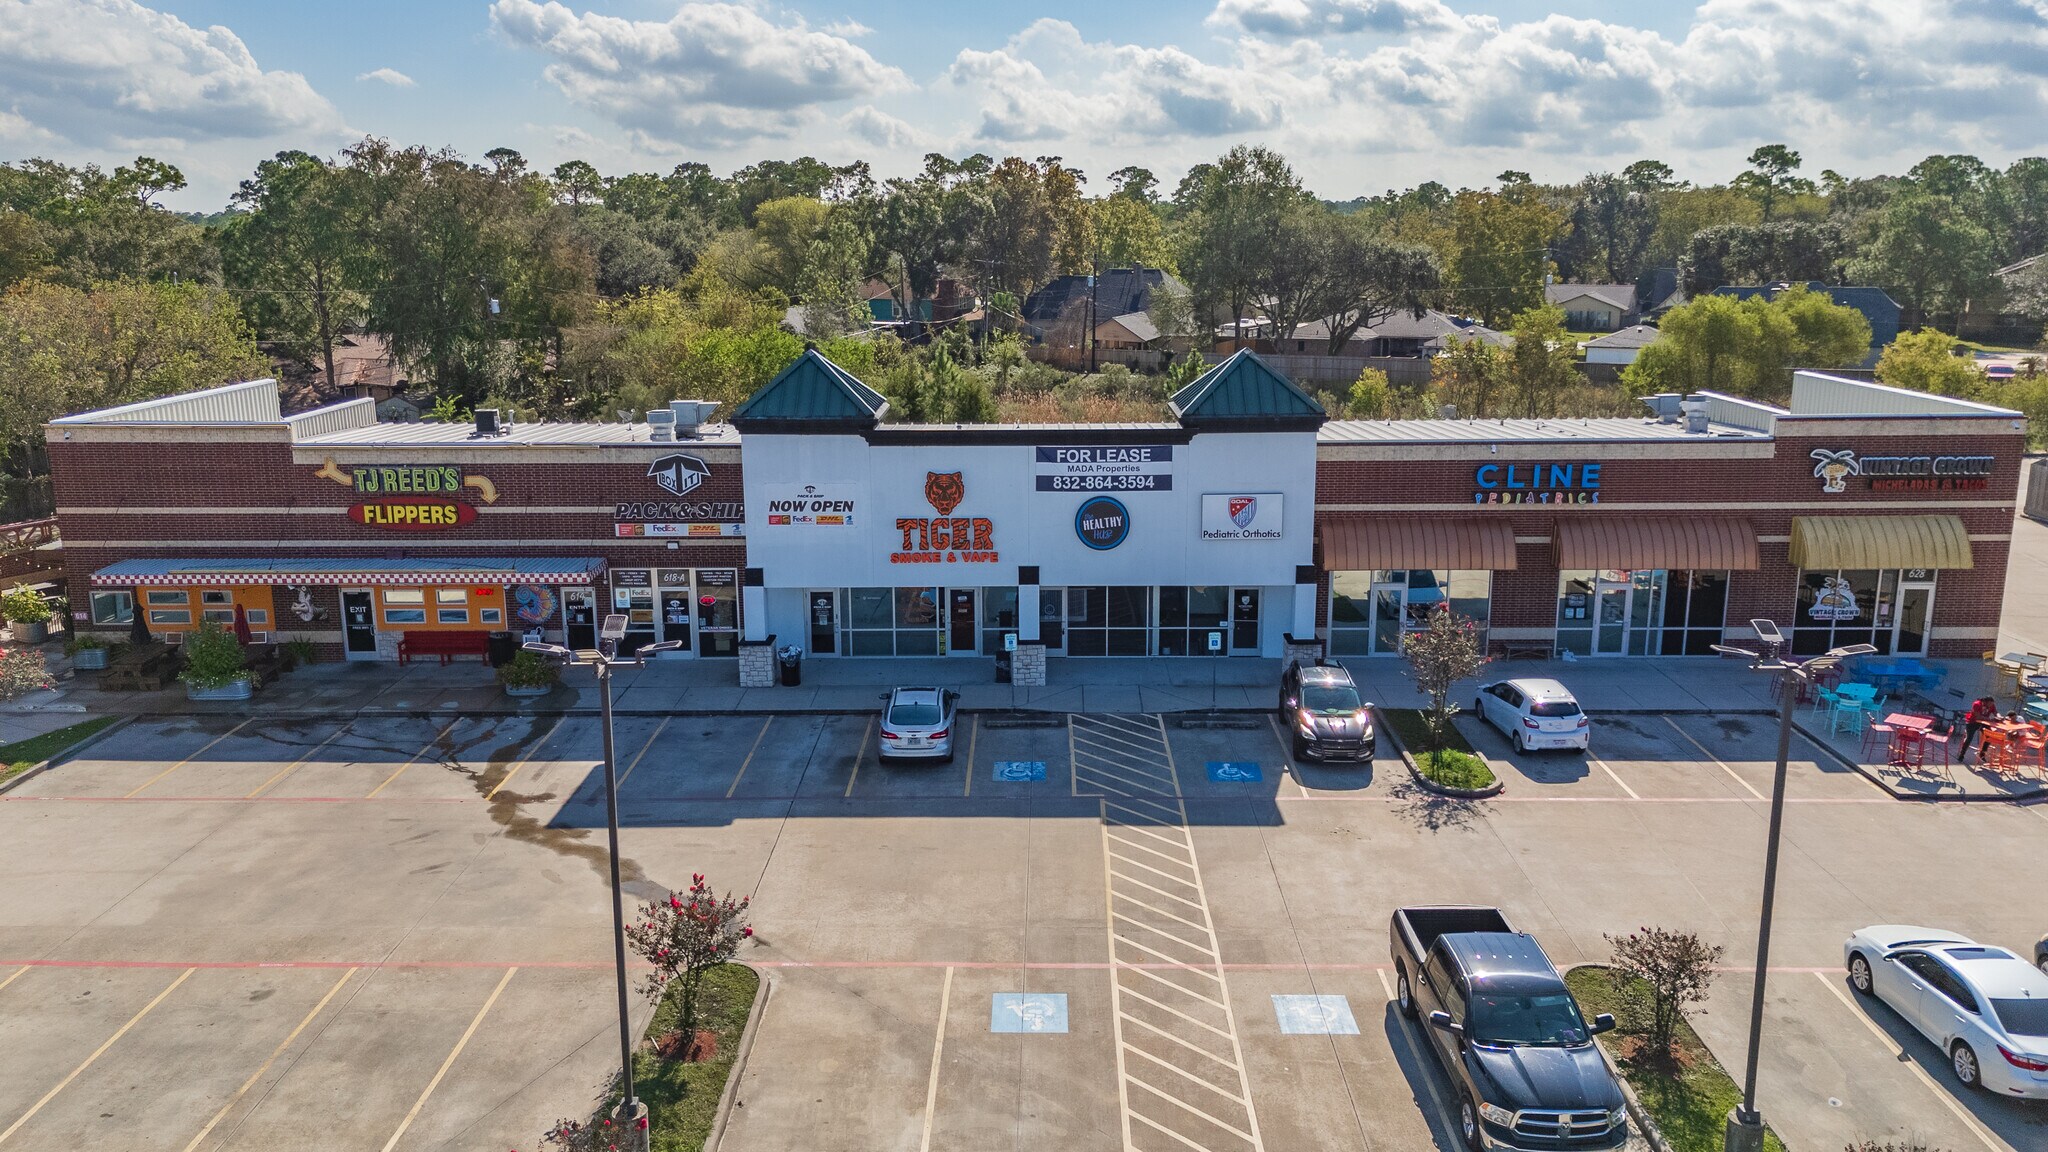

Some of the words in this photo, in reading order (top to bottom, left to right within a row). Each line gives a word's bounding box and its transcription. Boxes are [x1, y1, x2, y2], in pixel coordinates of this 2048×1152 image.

[1057, 449, 1092, 463] FOR
[1096, 448, 1151, 462] LEASE
[1067, 465, 1095, 473] MADA
[1096, 464, 1141, 474] Properties
[1860, 457, 1931, 475] VINTAGE
[1933, 456, 1994, 475] CROWN
[353, 468, 379, 492] TJ
[382, 466, 459, 492] REED'S
[660, 472, 678, 489] BOX
[684, 472, 696, 488] IT
[1053, 475, 1155, 490] 832-864-3594
[1476, 464, 1602, 489] CLINE
[1475, 491, 1600, 506] PEDIATRICS
[614, 502, 676, 519] PACK
[676, 502, 694, 519] &
[696, 502, 744, 519] SHIP
[769, 500, 808, 513] NOW
[810, 500, 854, 513] OPEN
[363, 505, 458, 524] FLIPPERS
[793, 515, 813, 523] FedEx
[652, 524, 677, 532] FedEx
[1083, 516, 1122, 531] HEALTHY
[896, 517, 994, 551] TIGER
[1203, 529, 1240, 539] Pediatric
[1242, 529, 1281, 538] Orthotics
[890, 552, 942, 564] SMOKE
[946, 551, 957, 563] &
[961, 551, 999, 563] VAPE
[663, 573, 685, 582] 618-A
[1908, 569, 1926, 578] 628
[632, 589, 652, 597] FedEx
